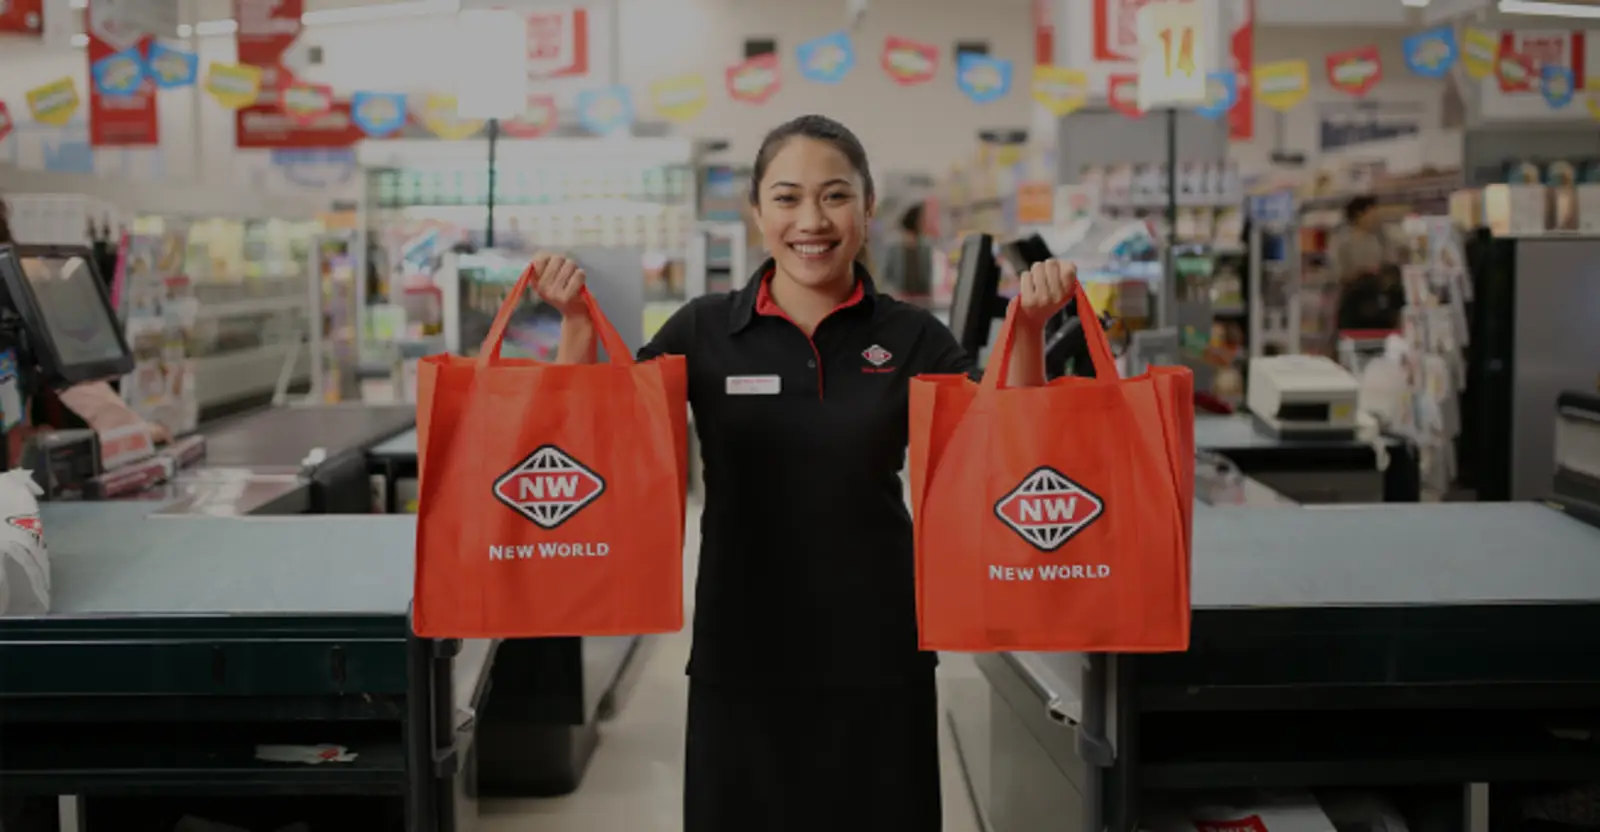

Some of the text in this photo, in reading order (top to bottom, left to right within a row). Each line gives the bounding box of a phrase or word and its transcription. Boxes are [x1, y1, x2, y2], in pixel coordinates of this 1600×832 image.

[1158, 27, 1196, 78] 14
[519, 475, 578, 500] NW
[1019, 496, 1077, 522] NW
[489, 542, 609, 560] NEW WORLD
[988, 564, 1110, 581] NEW WORLD
